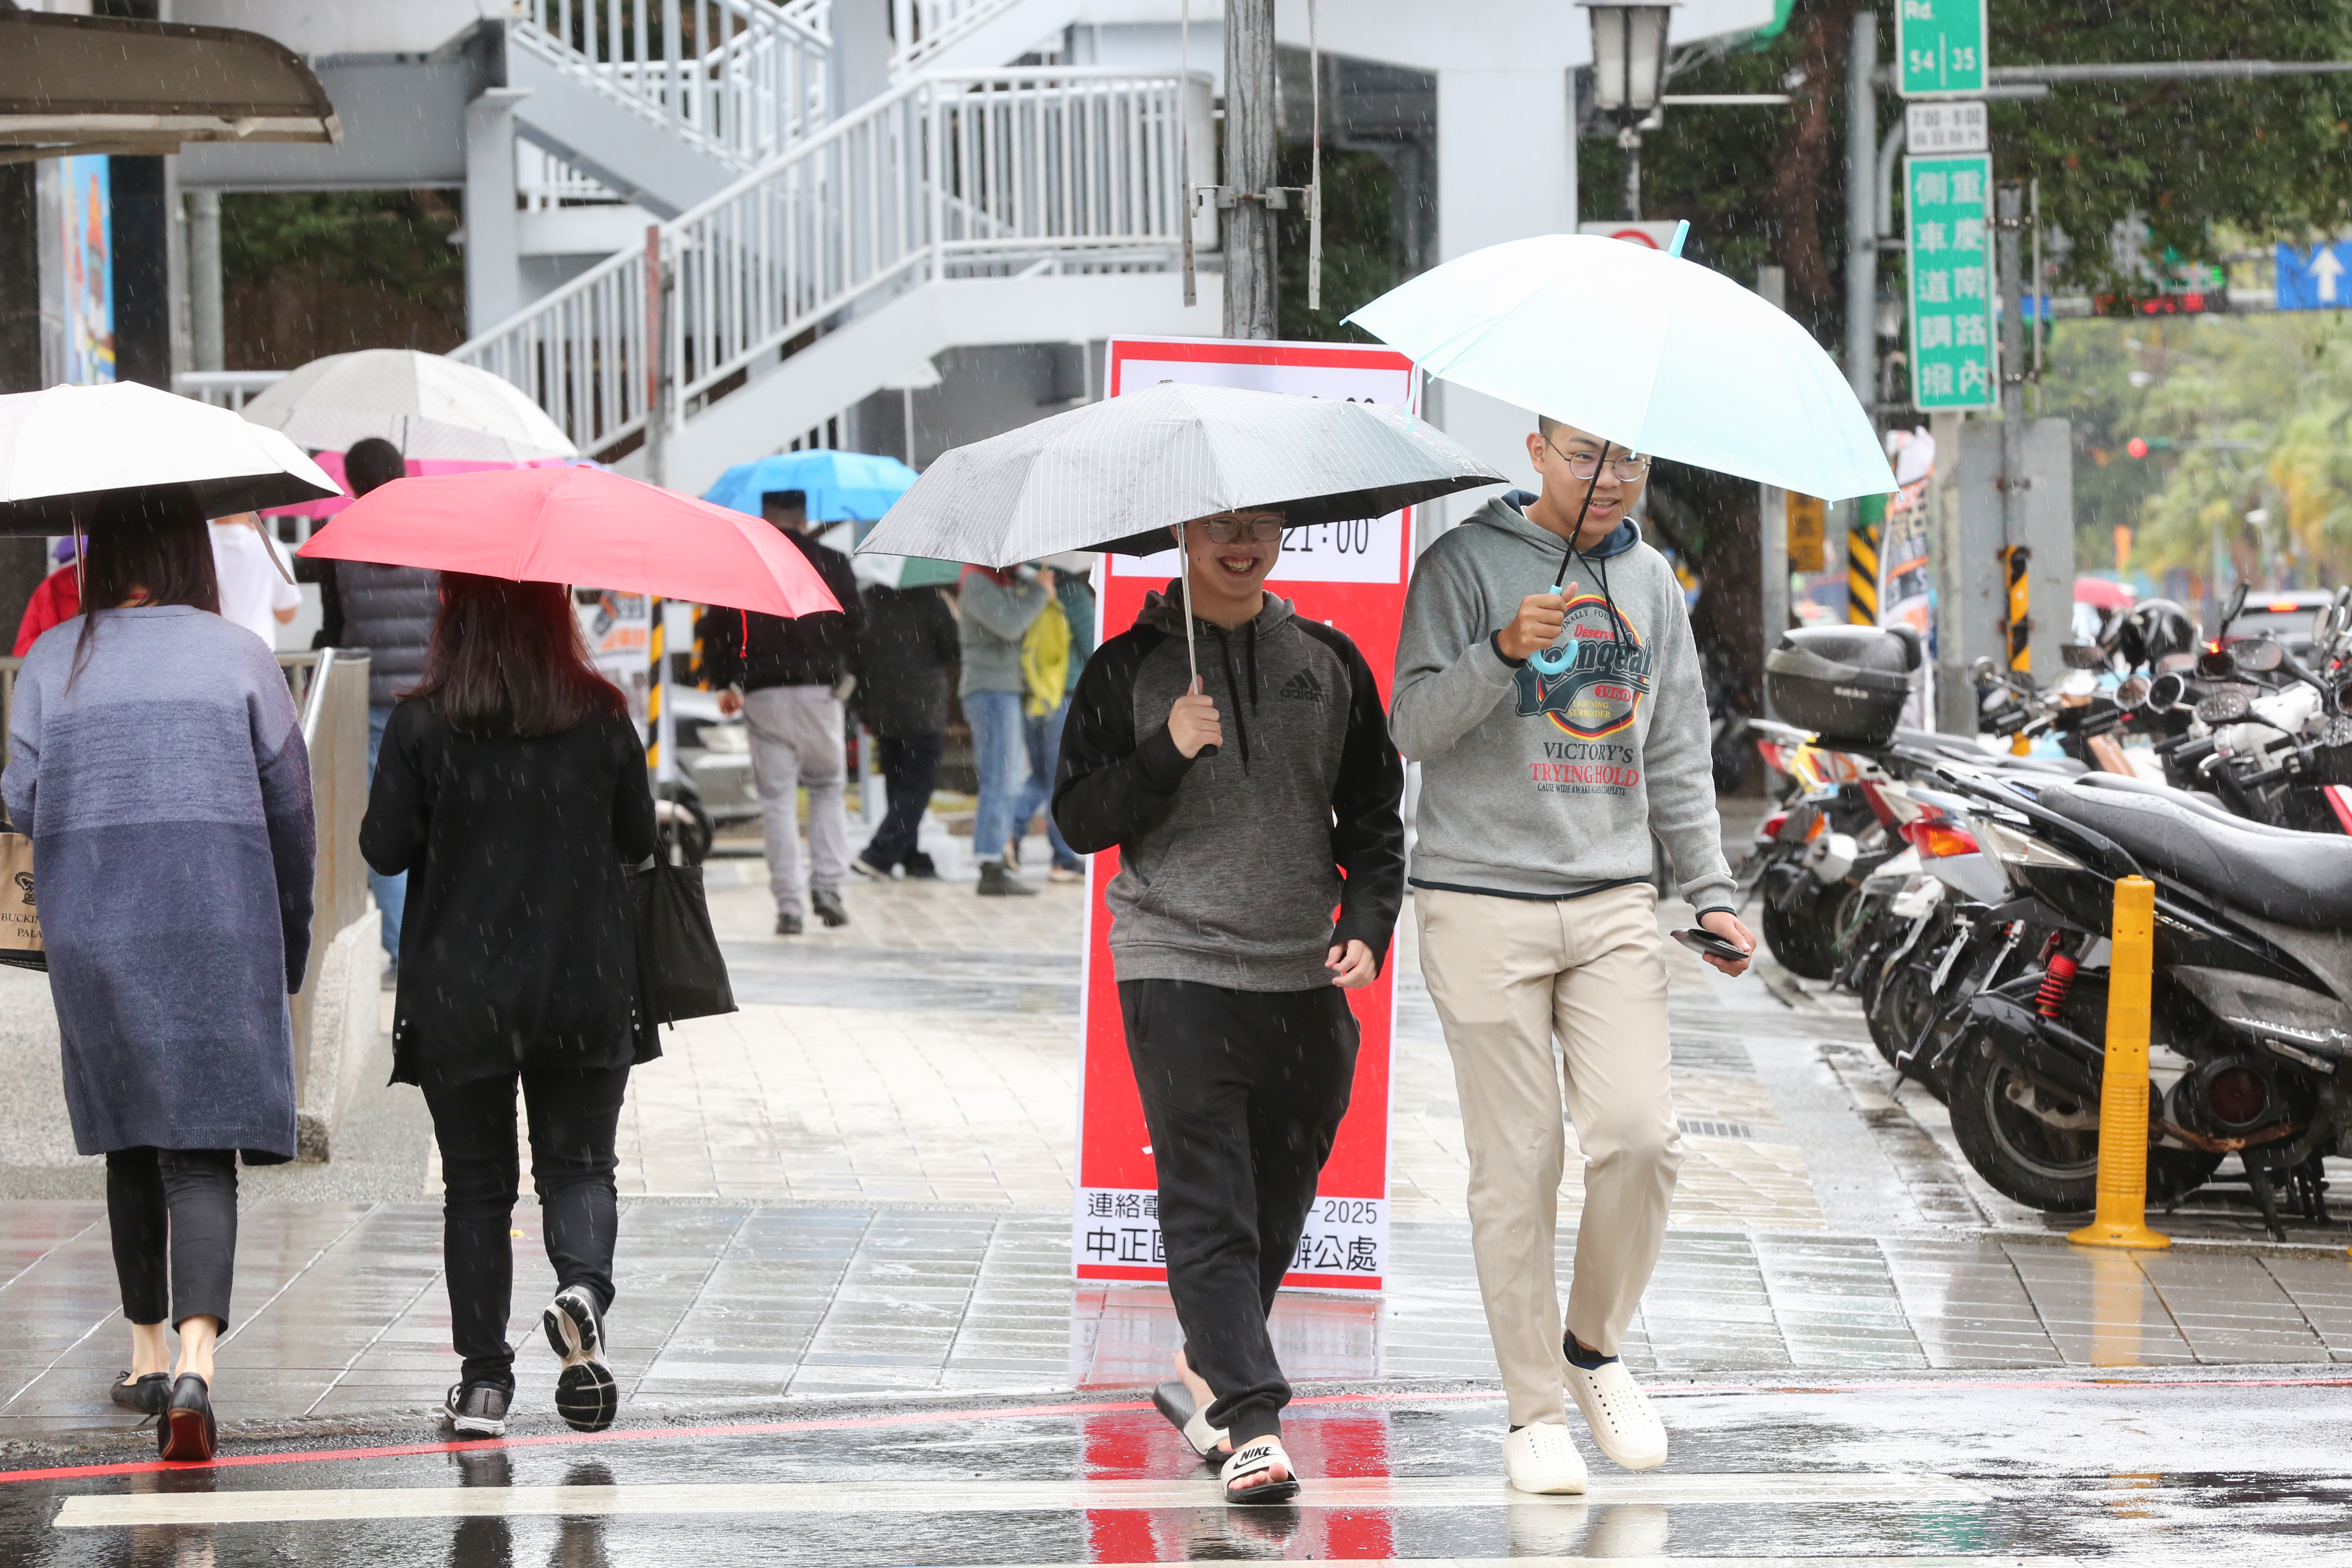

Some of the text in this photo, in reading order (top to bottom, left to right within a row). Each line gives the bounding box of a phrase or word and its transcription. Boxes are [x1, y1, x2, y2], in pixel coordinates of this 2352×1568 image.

[1910, 49, 1936, 74] 54
[1952, 47, 1976, 71] 35
[1561, 609, 1588, 633] INALLY
[1599, 686, 1629, 701] 1960
[1568, 709, 1611, 718] SURRENDER
[1573, 700, 1608, 709] LIGHTNING
[1543, 742, 1633, 763] VICTORY'S
[1530, 763, 1639, 786] TRYING HOLD
[1538, 783, 1554, 791] CAUSE
[1556, 784, 1570, 793] WIDE
[1572, 785, 1590, 793] AWAKE
[1601, 786, 1626, 796] COMPLETE
[1240, 1446, 1273, 1462] NIKE
